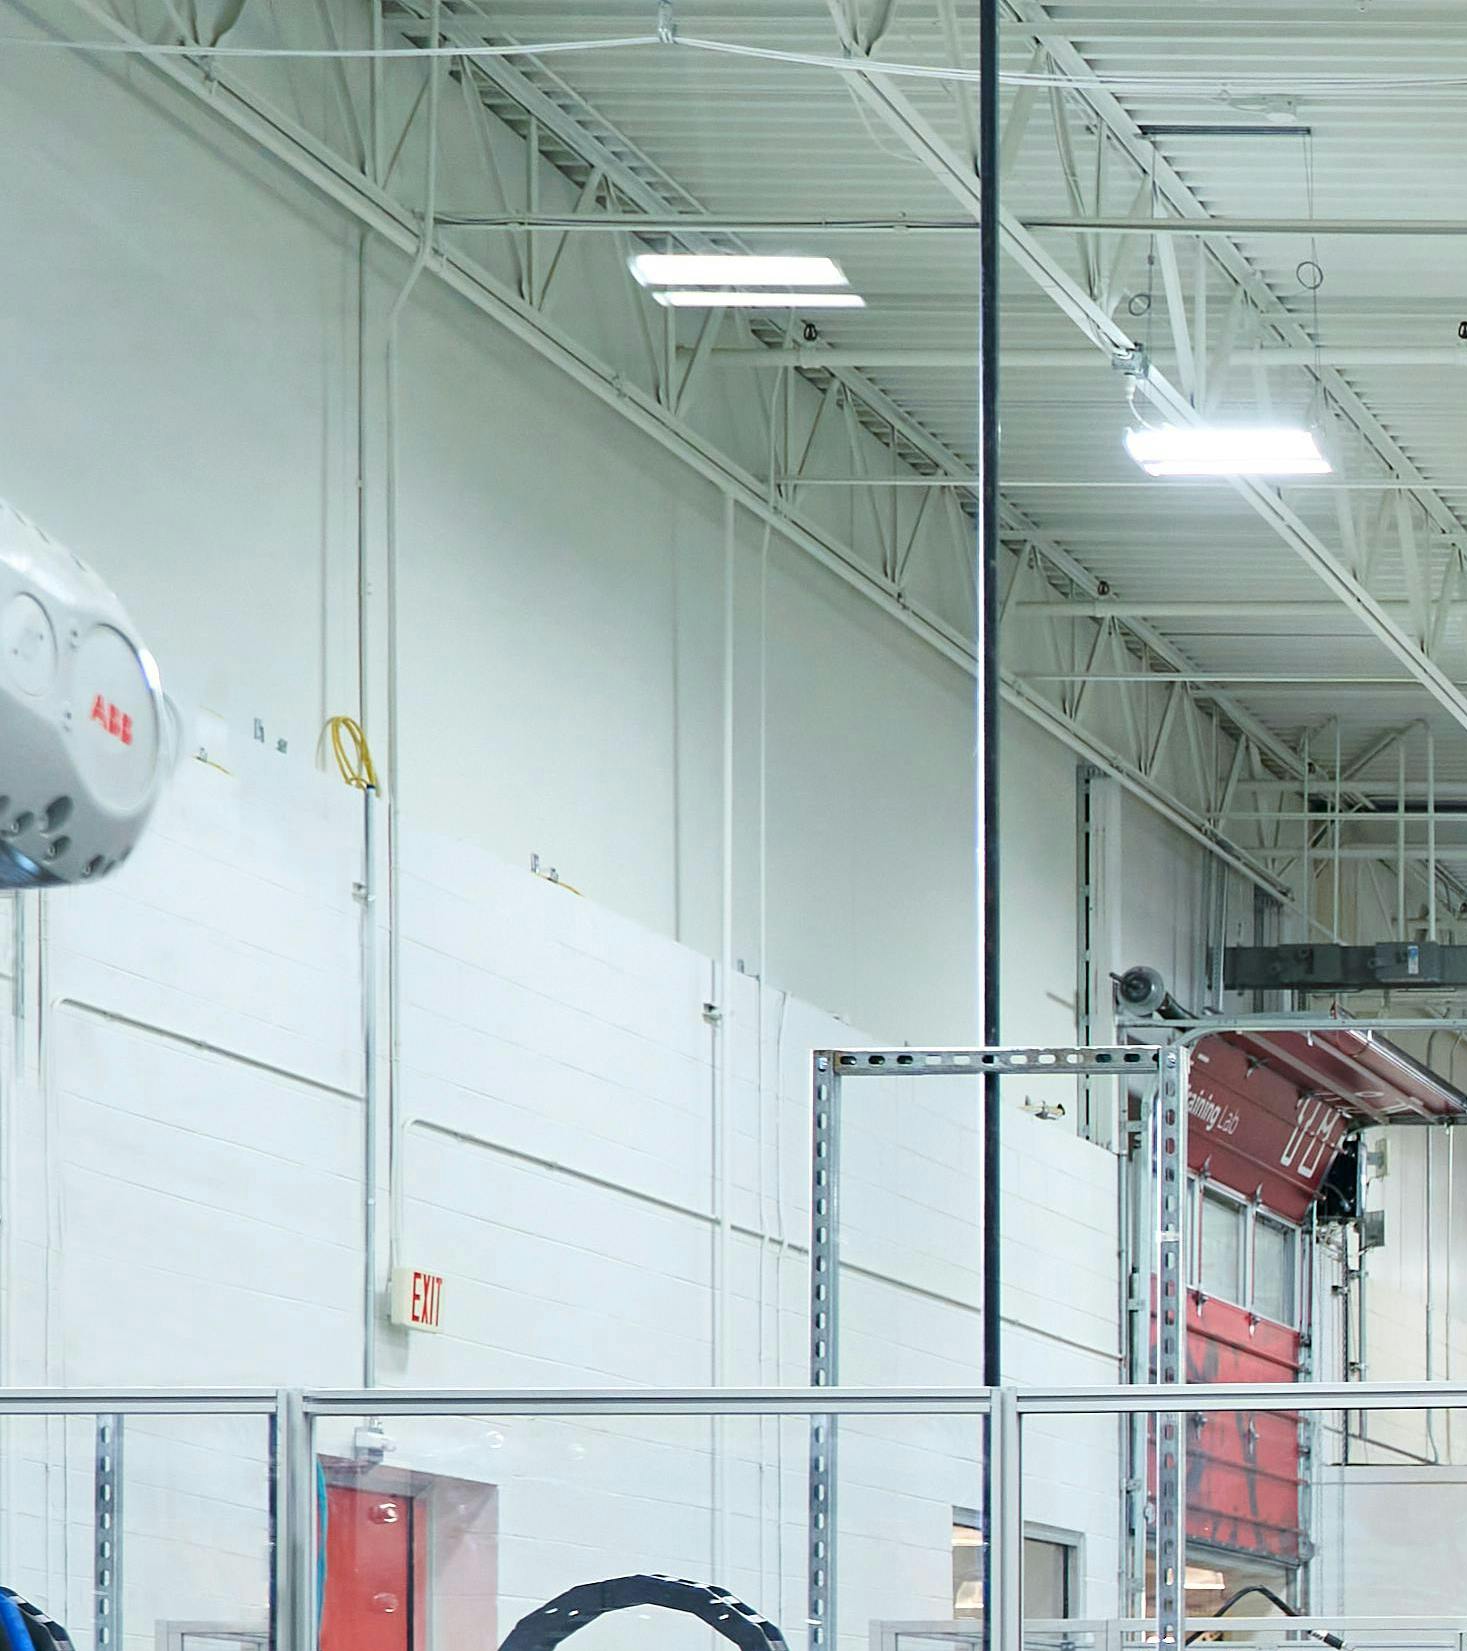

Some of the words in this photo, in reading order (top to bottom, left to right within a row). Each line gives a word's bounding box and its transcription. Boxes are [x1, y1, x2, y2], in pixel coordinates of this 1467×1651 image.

[91, 695, 133, 746] ABB
[1217, 1104, 1240, 1135] Lab
[411, 1271, 443, 1327] EXIT
